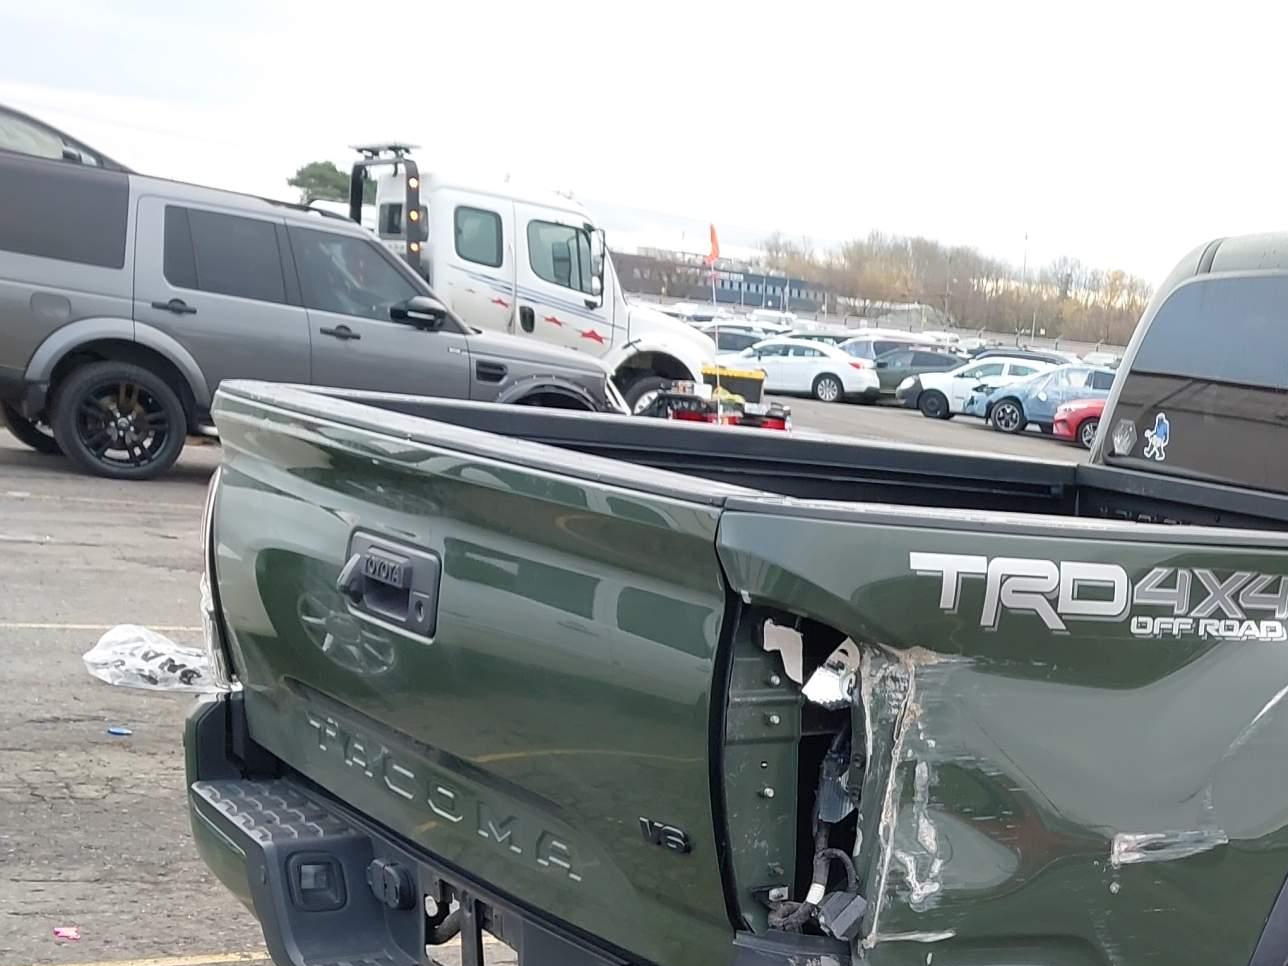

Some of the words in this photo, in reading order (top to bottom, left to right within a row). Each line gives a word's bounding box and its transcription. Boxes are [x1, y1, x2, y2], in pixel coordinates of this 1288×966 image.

[364, 554, 401, 583] TOYOTA
[909, 551, 1133, 635] TRD
[1130, 615, 1197, 641] OFF
[1197, 616, 1288, 642] ROAD
[306, 711, 582, 882] TACOMA
[638, 815, 692, 855] V6
